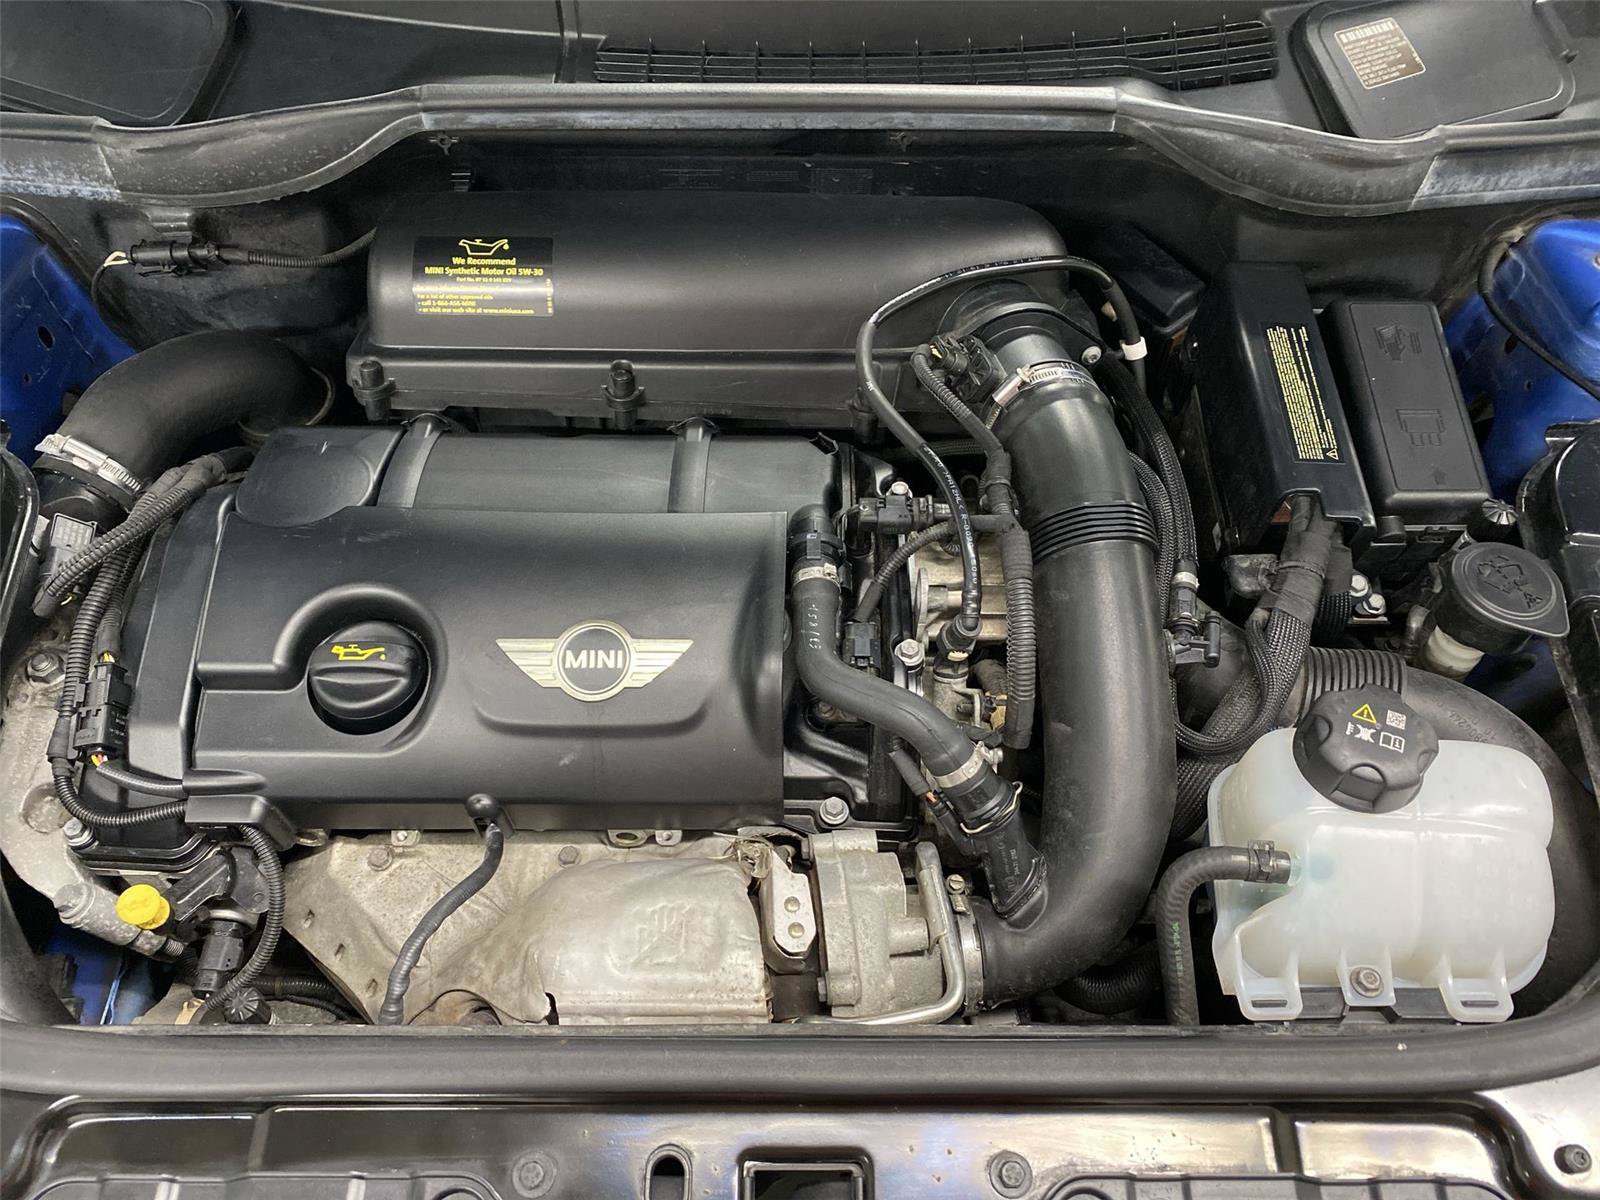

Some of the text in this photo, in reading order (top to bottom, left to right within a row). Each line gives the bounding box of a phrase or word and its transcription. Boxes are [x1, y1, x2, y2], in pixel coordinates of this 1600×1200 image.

[452, 257, 516, 266] We Recommend
[445, 267, 480, 276] Synthetic
[518, 268, 544, 276] 5W-30
[564, 649, 624, 669] MINI
